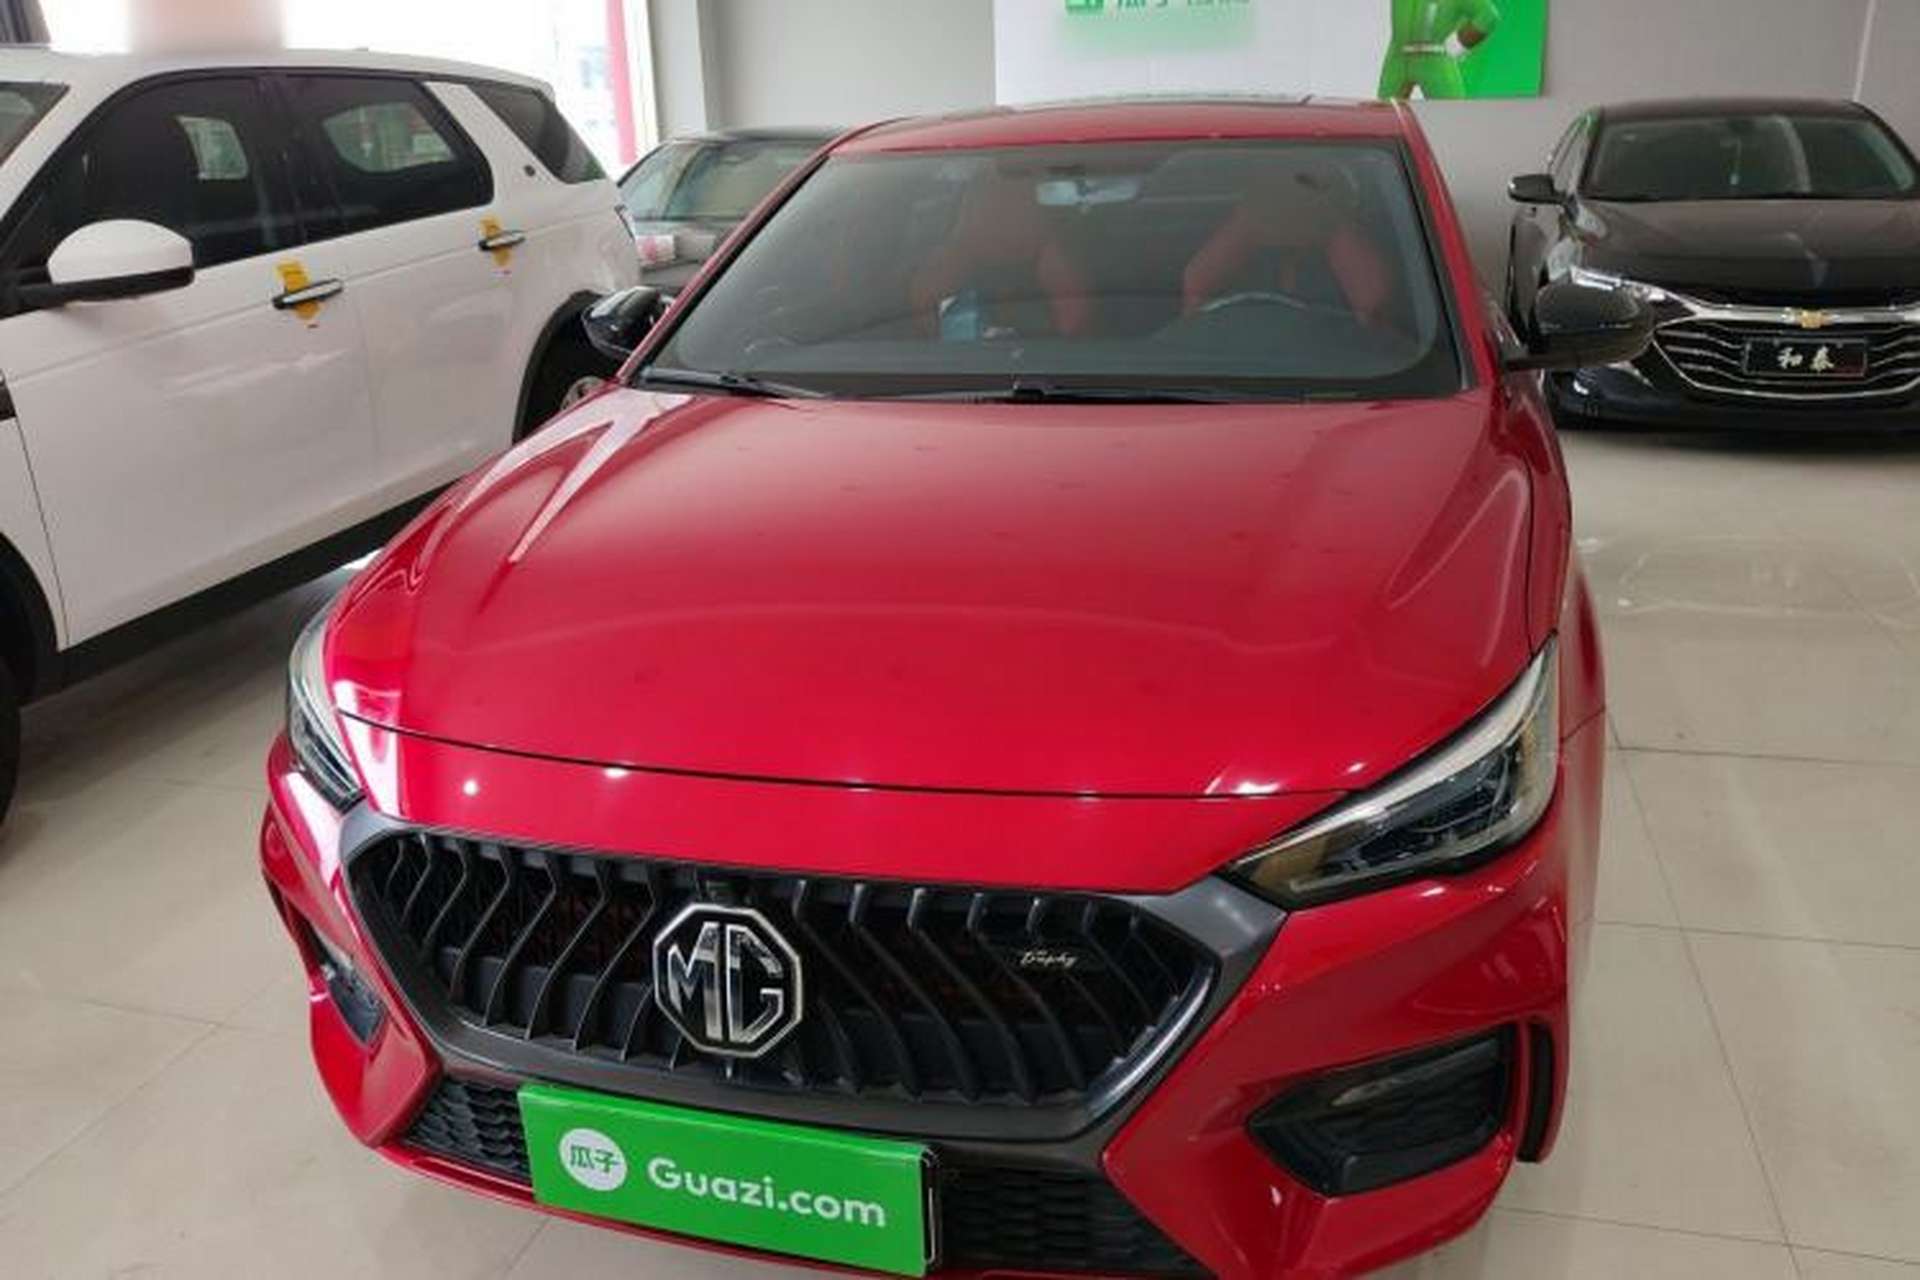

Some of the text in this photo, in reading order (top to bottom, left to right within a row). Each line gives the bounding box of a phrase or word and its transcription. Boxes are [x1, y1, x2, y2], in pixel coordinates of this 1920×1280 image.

[667, 920, 784, 1043] MG
[569, 1144, 620, 1173] 瓜子
[647, 1157, 886, 1228] Guazi.com
